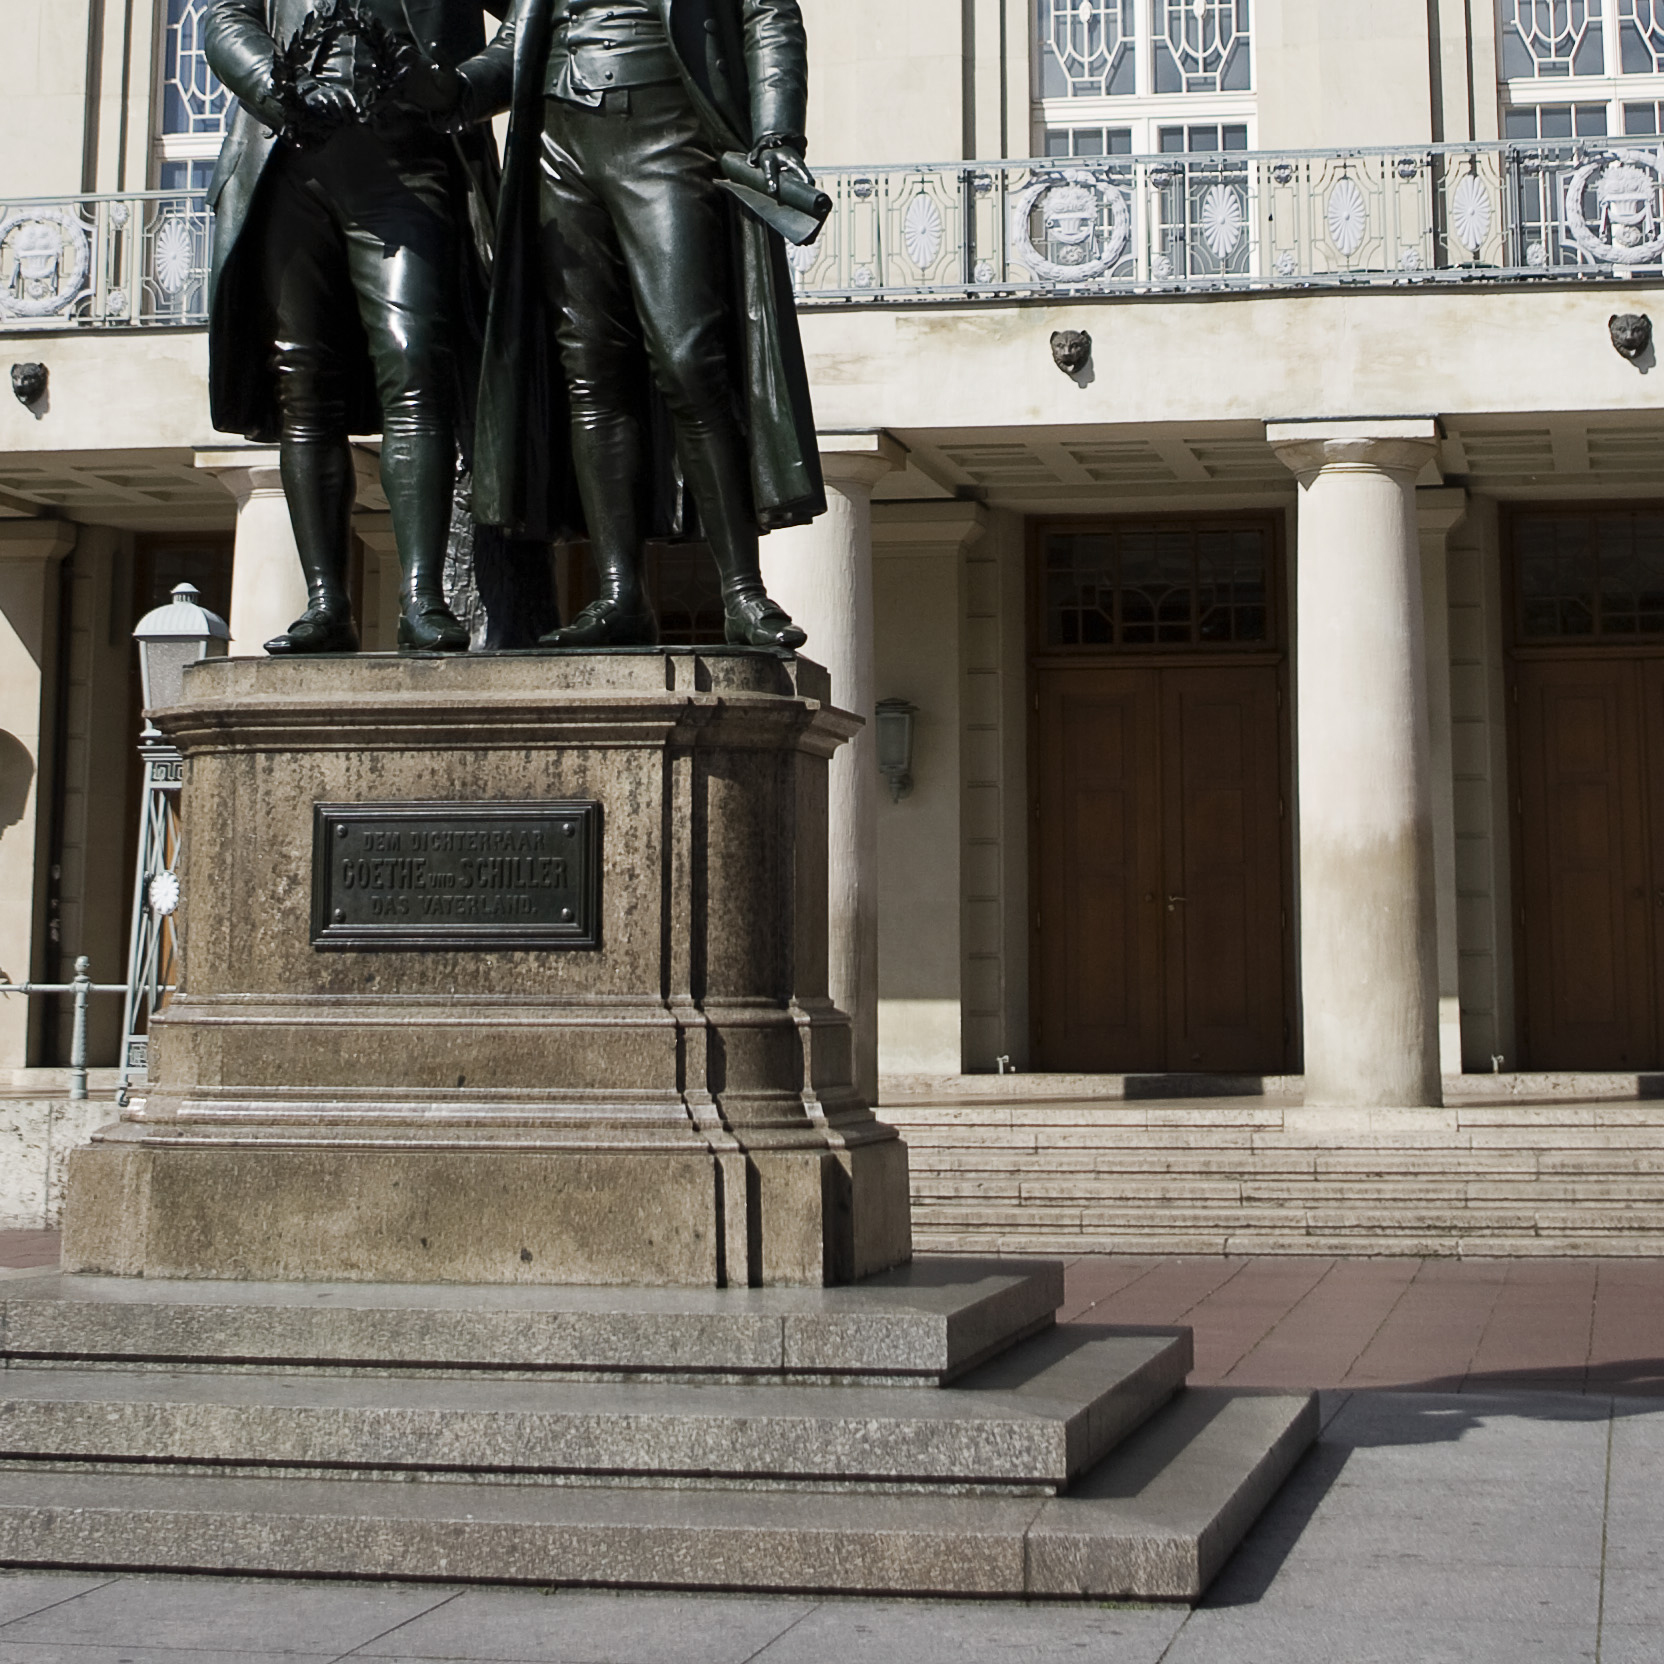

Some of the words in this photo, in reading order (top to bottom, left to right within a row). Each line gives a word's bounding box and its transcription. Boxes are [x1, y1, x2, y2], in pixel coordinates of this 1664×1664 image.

[362, 830, 402, 852] DEM
[409, 829, 546, 852] DICHTERPAAR
[341, 857, 427, 890] GOETHE
[428, 872, 456, 889] UND
[458, 856, 568, 890] SCHILLER
[370, 895, 410, 916] DAS
[418, 894, 539, 915] VATERLAND.
